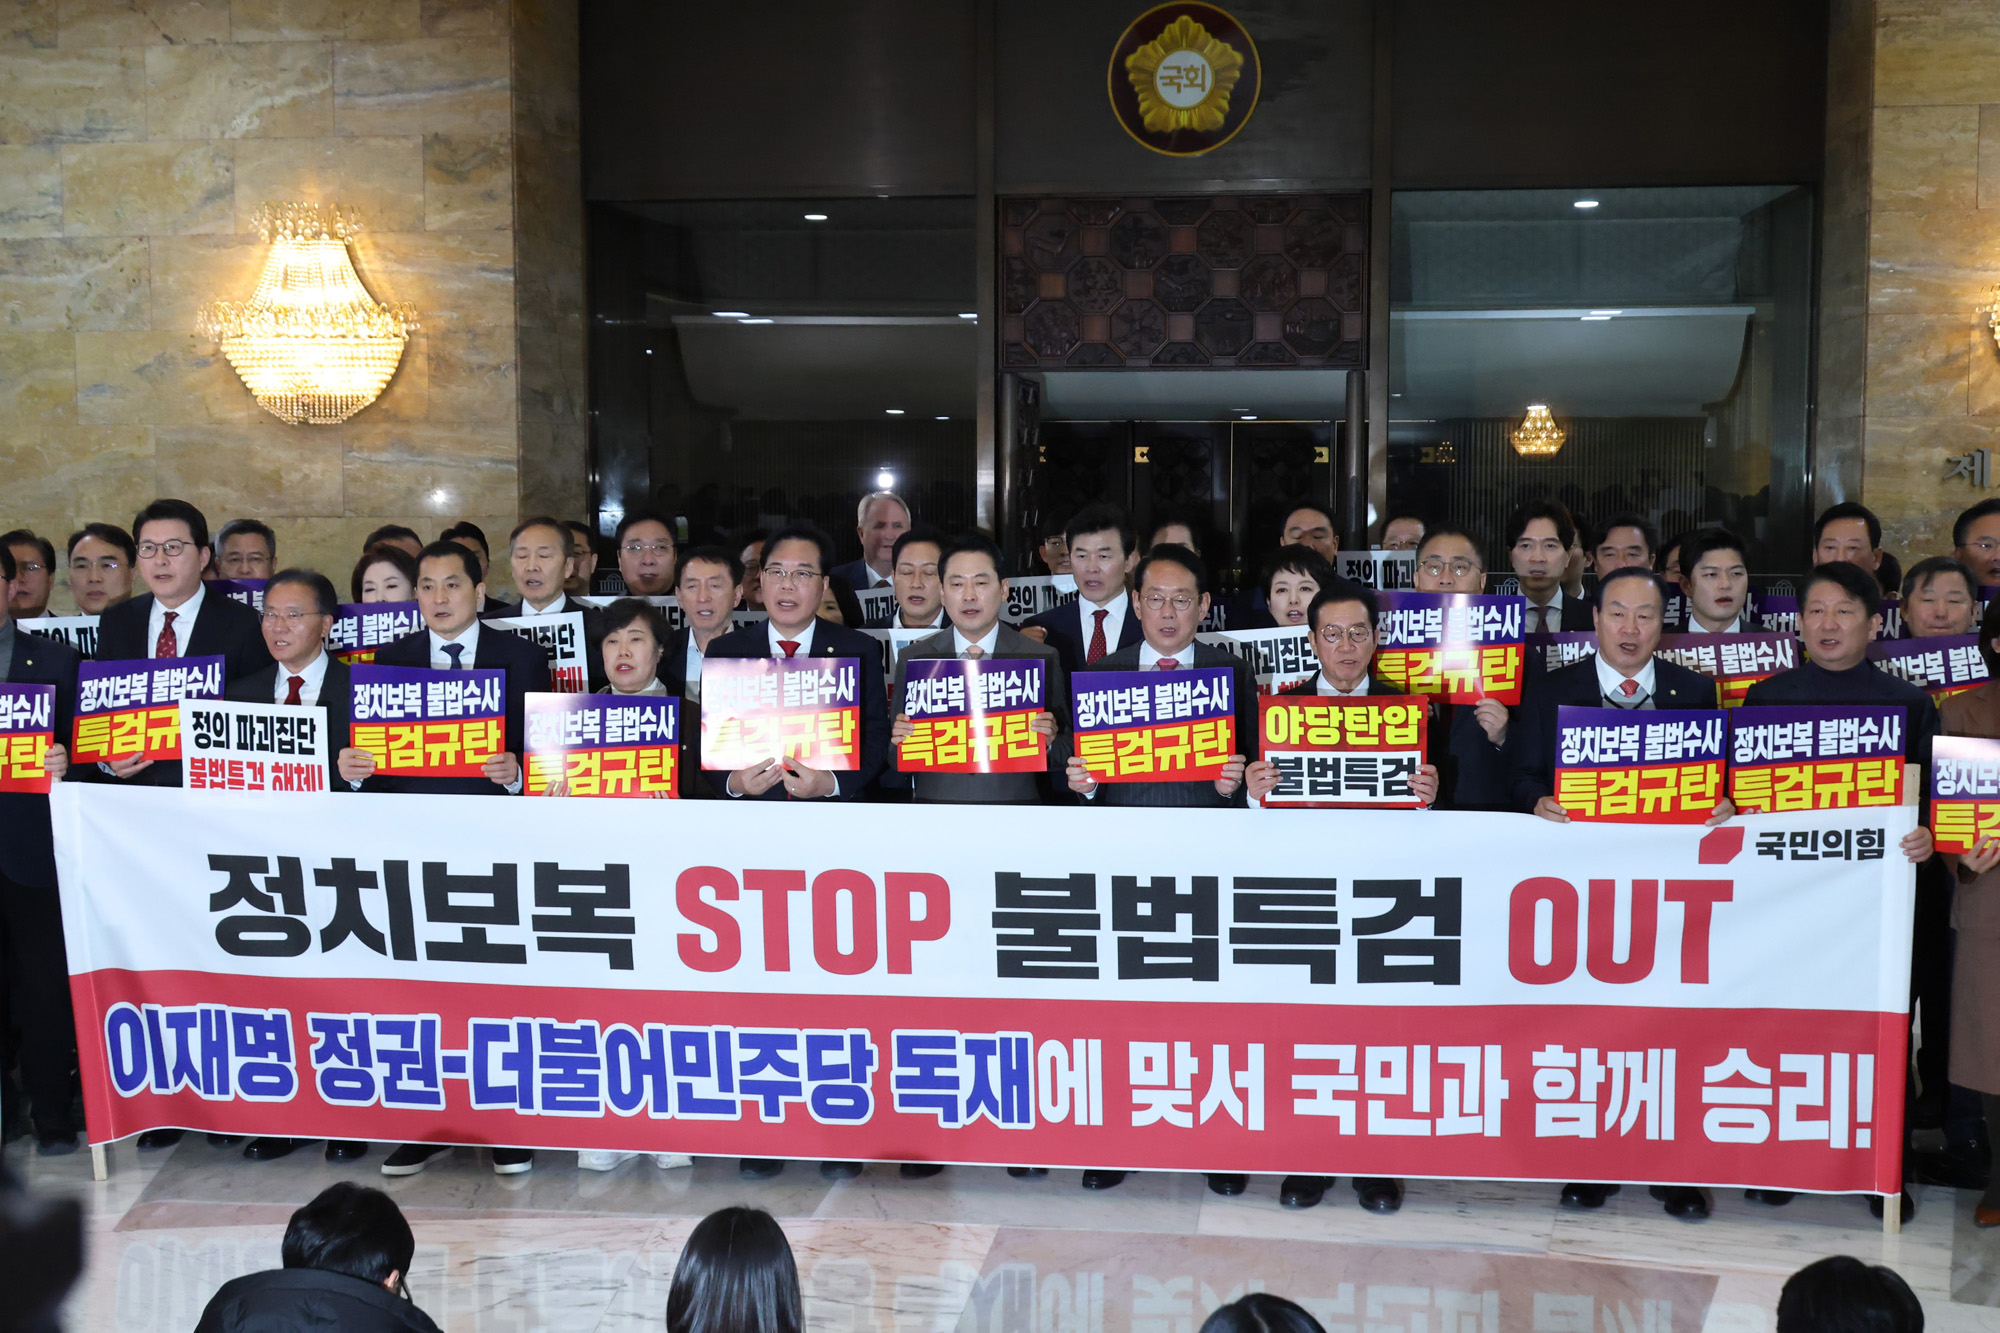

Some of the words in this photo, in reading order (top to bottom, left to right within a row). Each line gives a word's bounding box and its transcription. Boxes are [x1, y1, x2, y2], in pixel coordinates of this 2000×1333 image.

[1159, 64, 1206, 94] 국회
[1943, 447, 1993, 488] 제
[1007, 585, 1038, 616] 정의
[1376, 607, 1442, 645] 정치보복
[1448, 603, 1521, 642] 불법수사
[1376, 646, 1520, 694] 특검규탄
[1720, 638, 1793, 674] 불법수사
[80, 671, 148, 712] 정치보복
[152, 662, 221, 702] 불법수사
[353, 681, 422, 719] 정치보복
[427, 677, 501, 715] 불법수사
[707, 672, 778, 713] 정치보복
[783, 665, 855, 707] 불법수사
[905, 675, 965, 716] 정치보복
[970, 667, 1040, 710] 불법수사
[1076, 686, 1150, 727] 정치보복
[1155, 676, 1230, 718] 불법수사
[192, 711, 230, 749] 정의
[236, 714, 316, 755] 파괴집단
[354, 719, 501, 769] 특검규탄
[529, 708, 600, 748] 정치보복
[605, 705, 675, 743] 불법수사
[708, 709, 856, 759] 특검규탄
[901, 711, 1039, 766] 특검규탄
[1079, 719, 1231, 778] 특검규탄
[1265, 705, 1423, 745] 야당탄압
[1561, 724, 1639, 764] 정치보복
[1645, 718, 1722, 761] 불법수사
[1734, 720, 1814, 763] 정치보복
[1818, 715, 1900, 757] 불법수사
[528, 747, 675, 795] 특검규탄
[1270, 756, 1417, 797] 불법특검
[1558, 763, 1720, 817] 특검규탄
[1733, 758, 1900, 813] 특검규탄
[1755, 827, 1885, 861] 국민의힘
[208, 853, 636, 971] 정치보복
[676, 865, 951, 975] STOP
[992, 870, 1462, 986] 불법특검
[1508, 876, 1735, 985] OUT
[104, 1000, 298, 1104] 이재명
[309, 1011, 878, 1126] 정권-더불어민주당
[890, 1027, 1103, 1130] 독재에
[1129, 1040, 1266, 1131] 맞서
[1291, 1043, 1509, 1138] 국민과
[1532, 1043, 1676, 1142] 함께
[1701, 1047, 1875, 1150] 승리!
